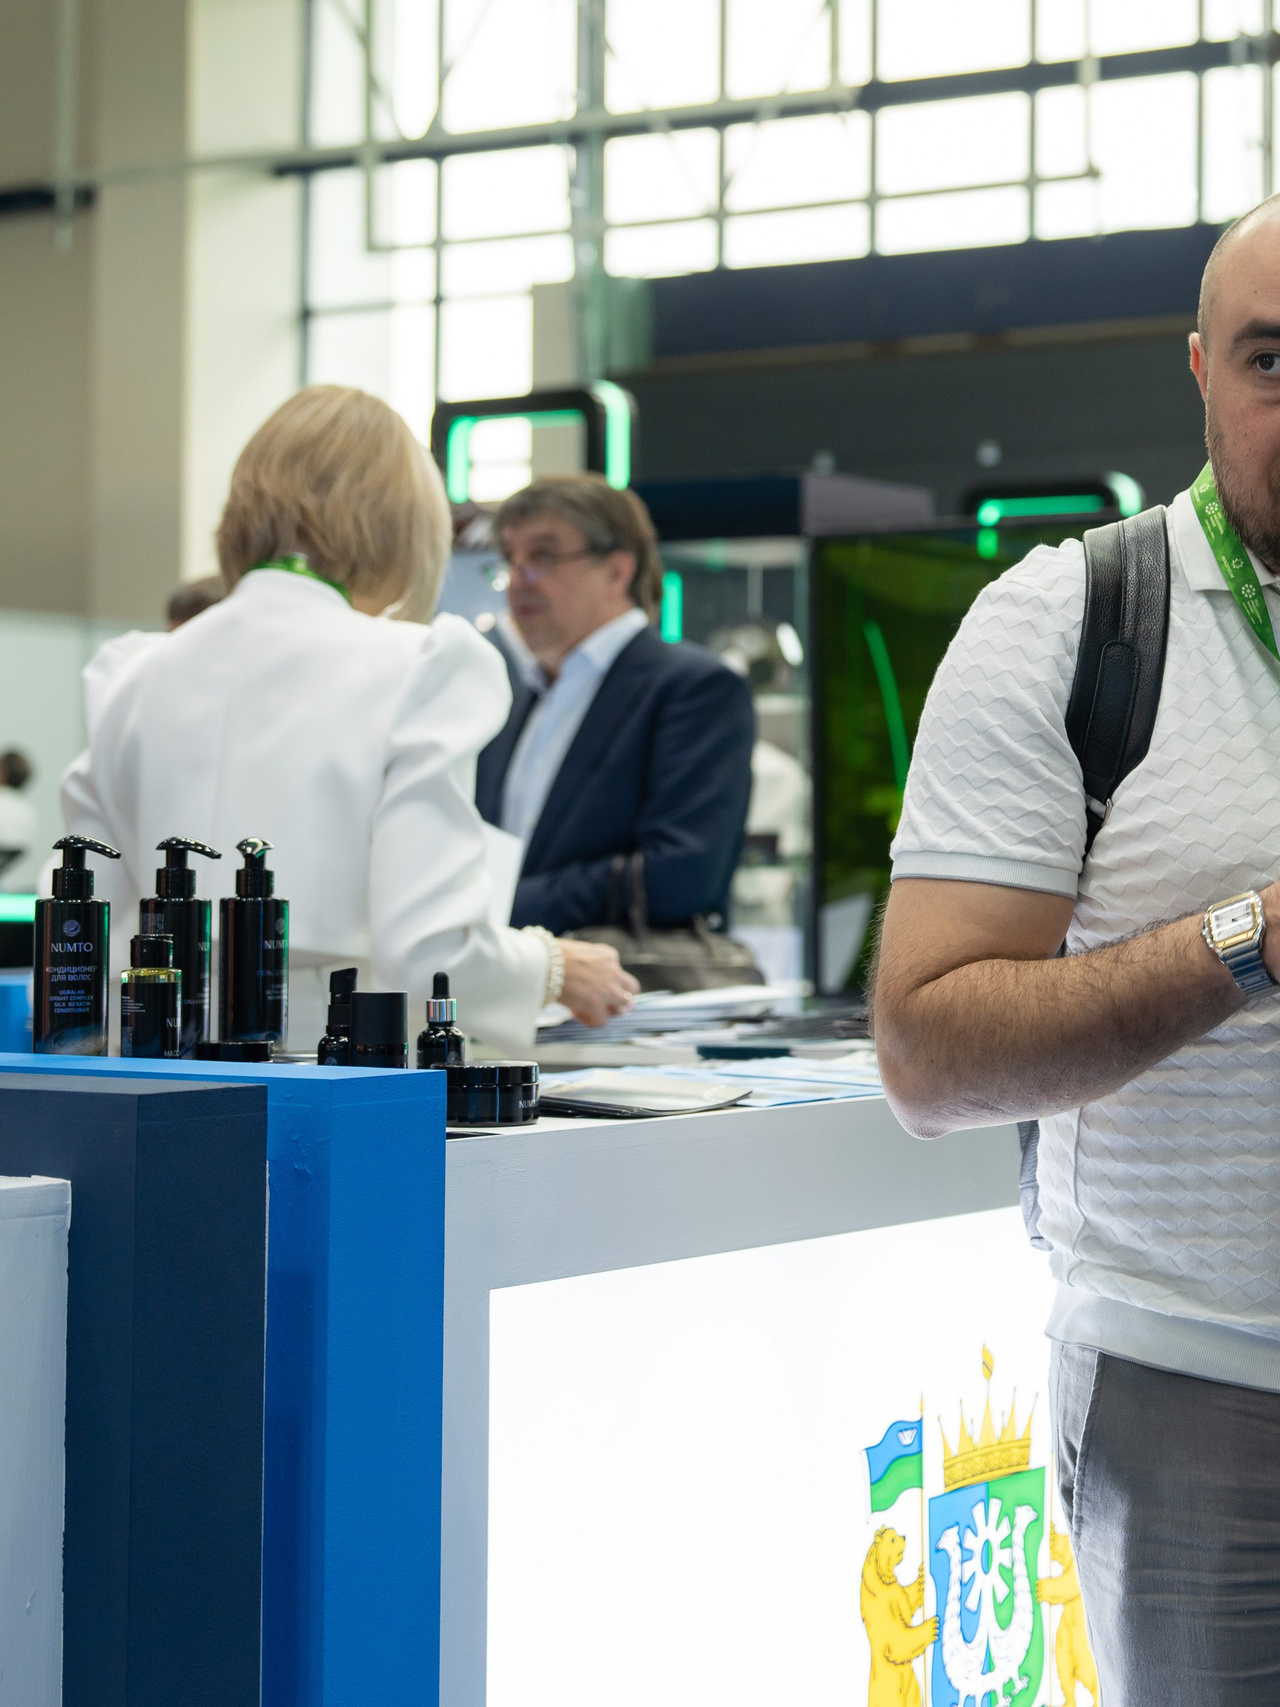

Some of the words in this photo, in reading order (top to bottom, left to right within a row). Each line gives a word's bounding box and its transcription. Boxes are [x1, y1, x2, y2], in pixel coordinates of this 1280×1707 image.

[51, 942, 93, 953] NUMTO
[45, 965, 98, 974] КОНДИЦИОНЕР
[51, 974, 67, 982] ДЛЯ
[67, 974, 92, 982] ВОЛОС
